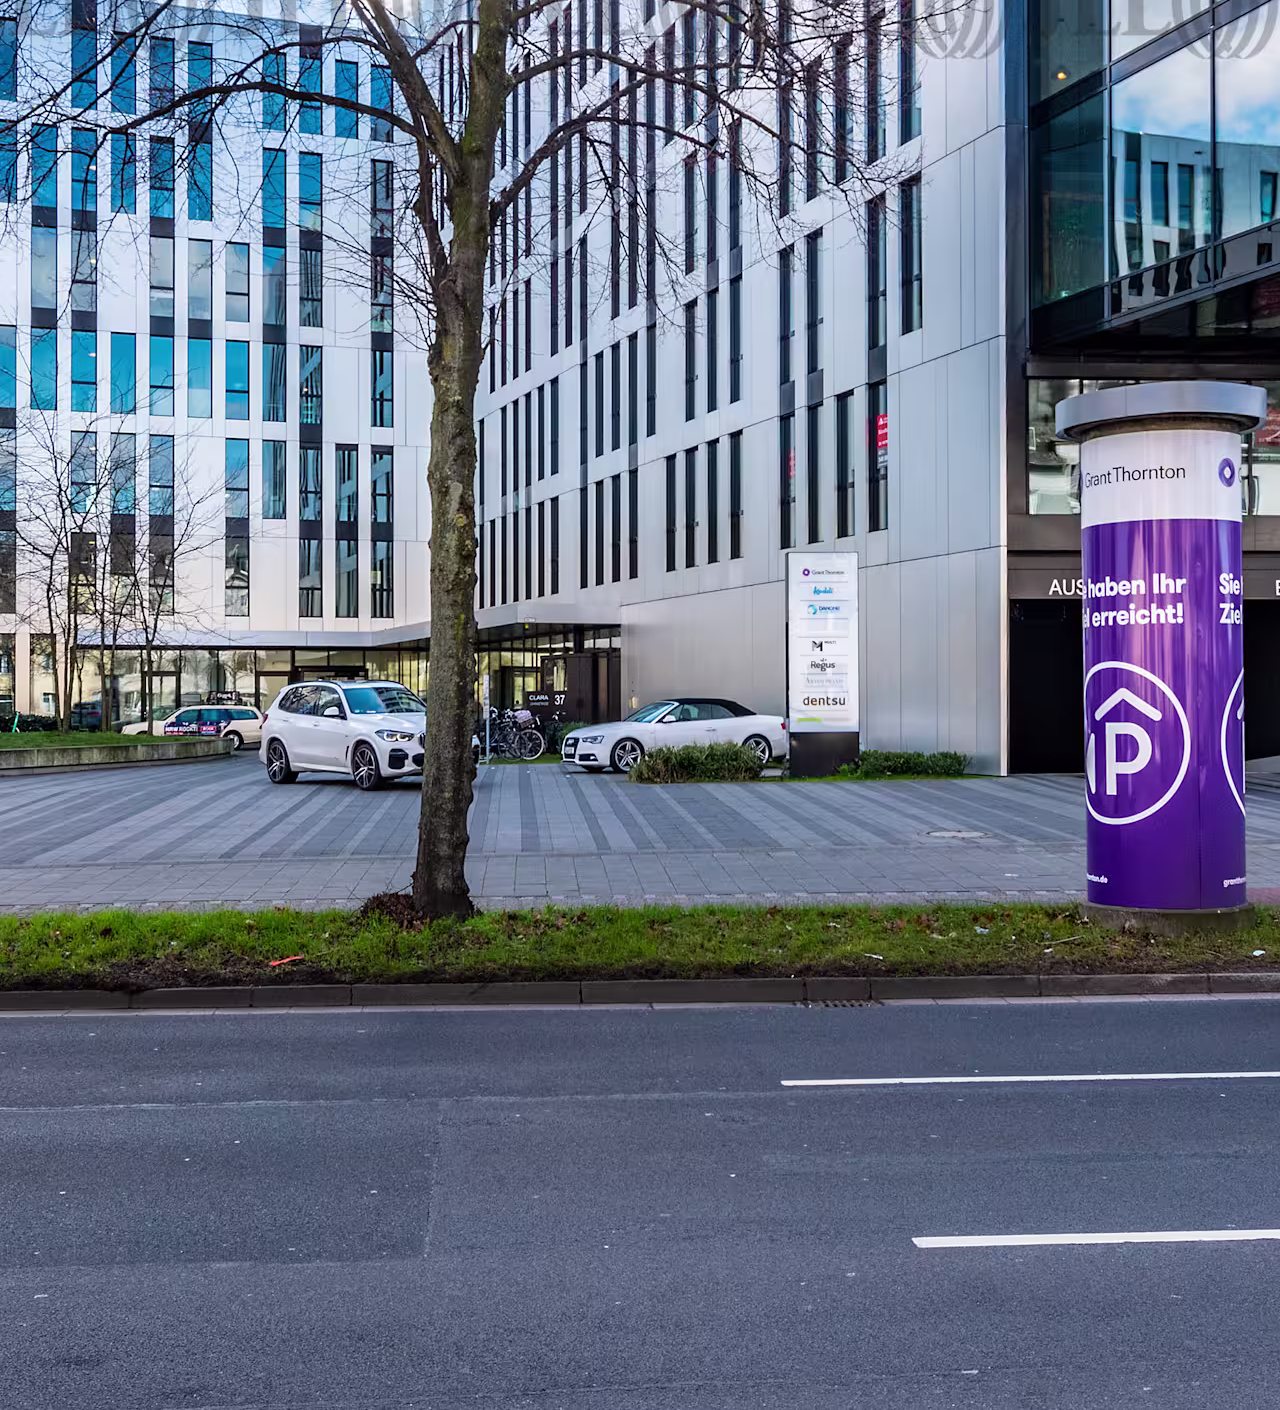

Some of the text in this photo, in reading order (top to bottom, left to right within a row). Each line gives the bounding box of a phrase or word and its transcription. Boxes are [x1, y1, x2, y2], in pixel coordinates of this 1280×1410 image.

[1084, 465, 1186, 489] Grant Thornton
[1048, 578, 1083, 596] AUS
[1088, 576, 1146, 599] haben
[1152, 573, 1187, 594] Ihr
[1219, 573, 1240, 595] Sie
[1091, 602, 1184, 627] erreicht!
[810, 660, 835, 672] Regus
[554, 694, 565, 705] 37
[802, 695, 846, 706] dentsu
[1105, 722, 1153, 796] P
